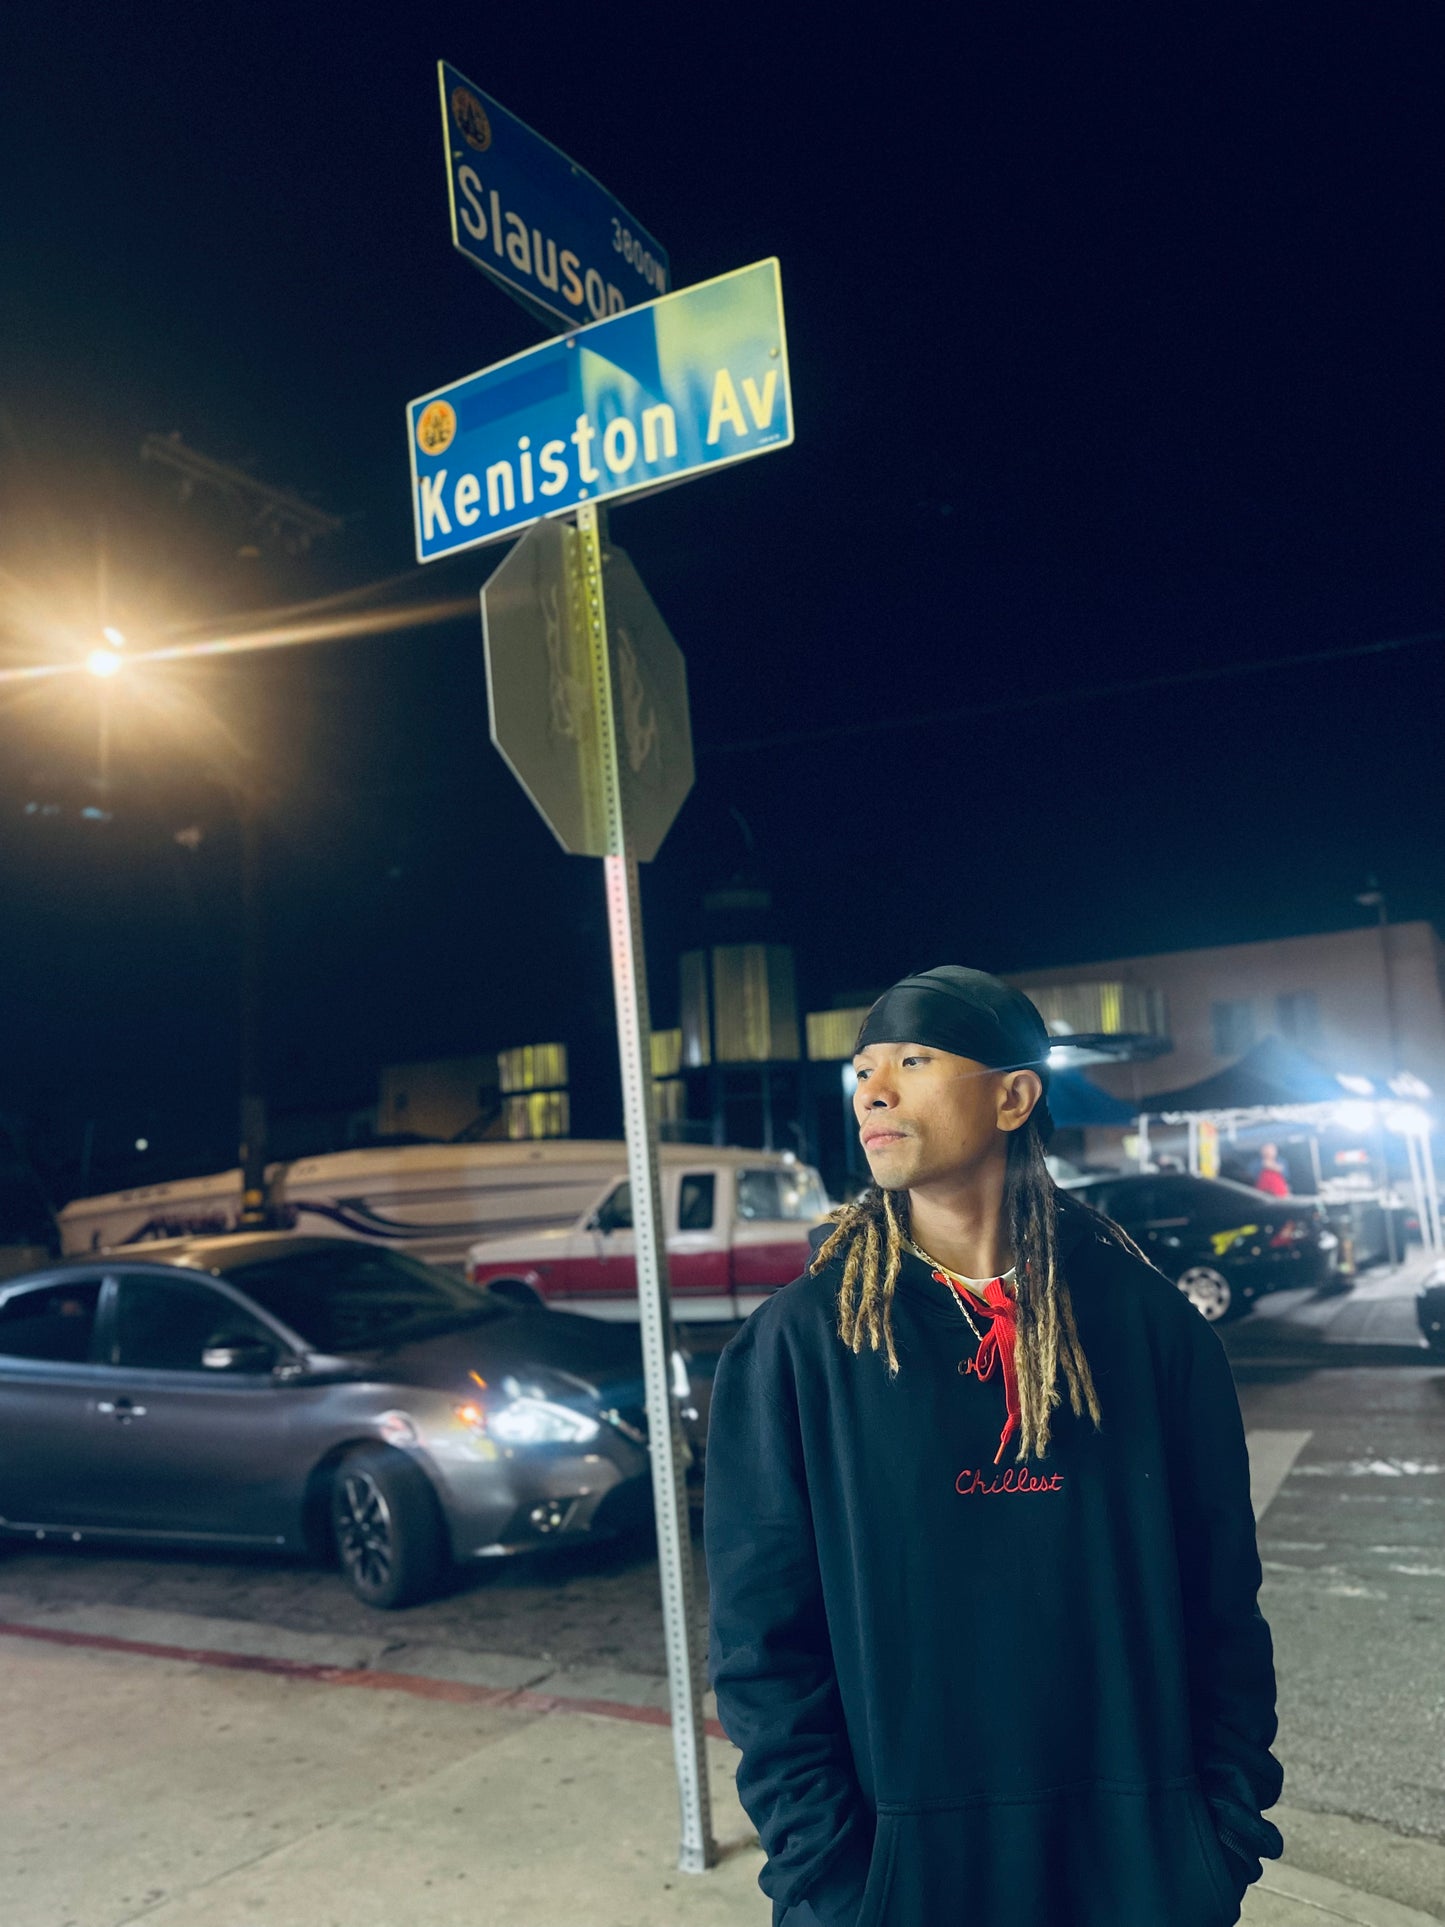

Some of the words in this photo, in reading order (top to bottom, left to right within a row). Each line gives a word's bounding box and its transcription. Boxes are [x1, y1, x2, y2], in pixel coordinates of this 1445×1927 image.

[458, 165, 625, 319] Slauson
[420, 403, 678, 540] Keniston
[706, 368, 777, 445] Av
[955, 1467, 1064, 1494] Chillest
